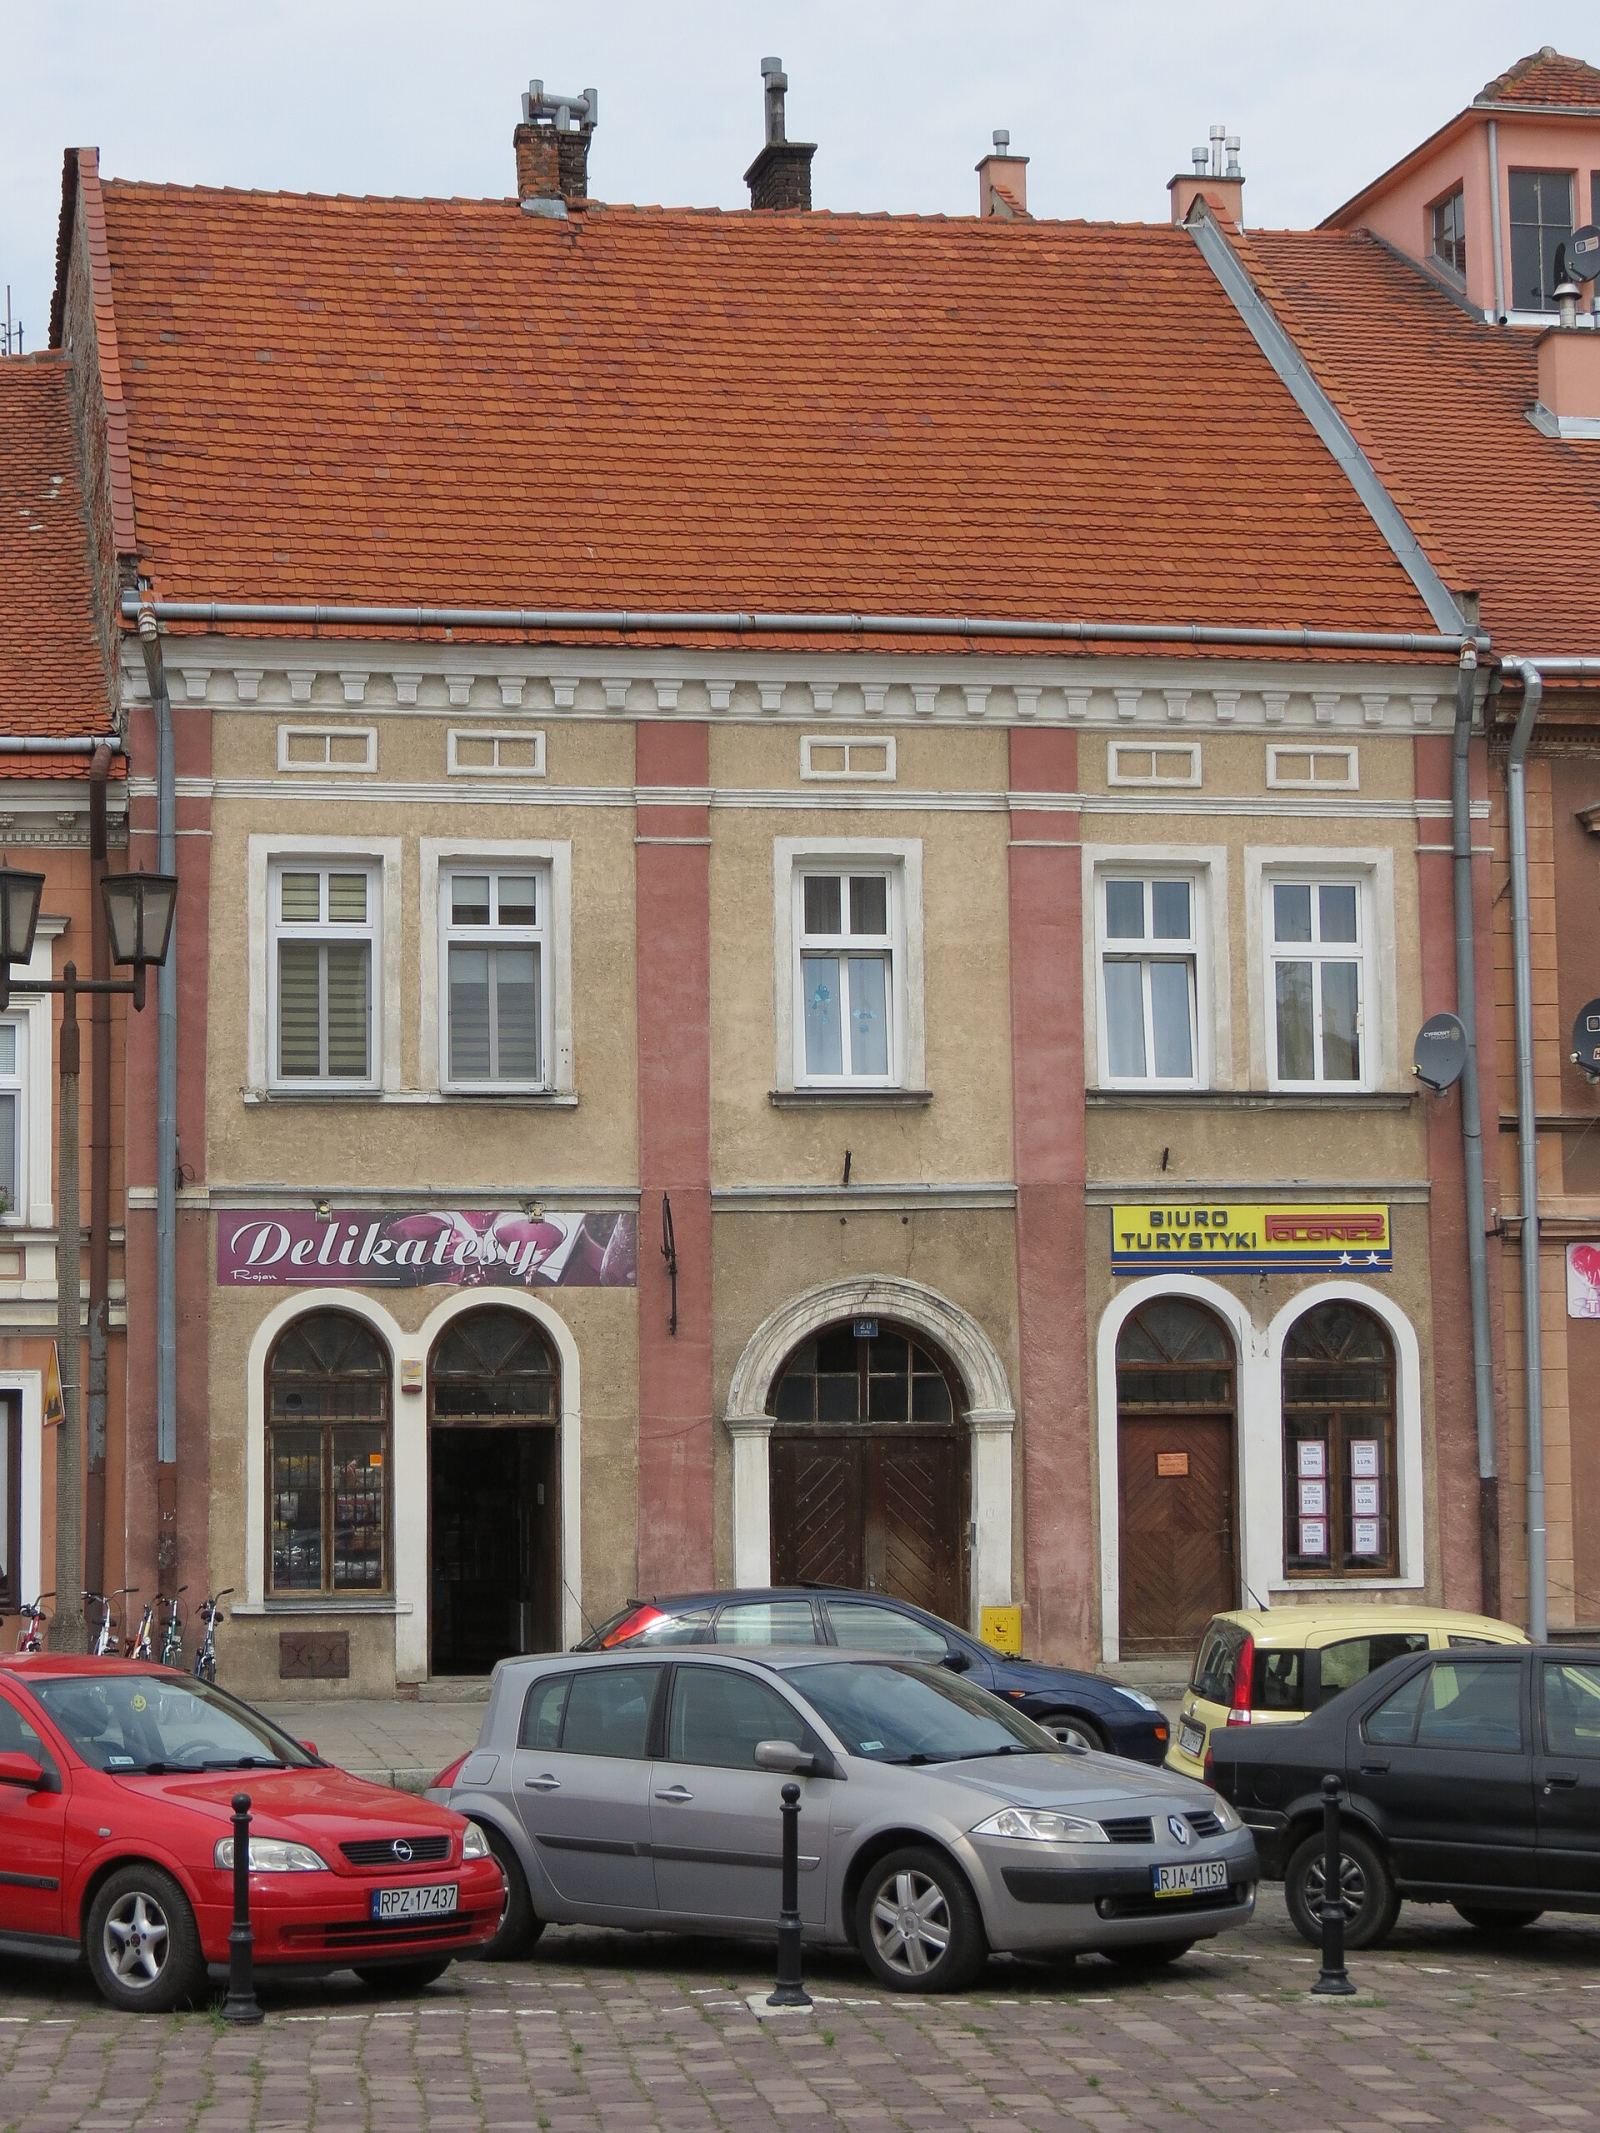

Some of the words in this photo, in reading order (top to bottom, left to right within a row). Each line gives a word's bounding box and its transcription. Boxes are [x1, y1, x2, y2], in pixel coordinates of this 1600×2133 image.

[1149, 1210, 1228, 1227] BIURO
[1264, 1213, 1385, 1242] POLONEZ
[230, 1221, 538, 1275] Delikatesy
[1121, 1232, 1257, 1249] TURYSTYKI
[230, 1269, 278, 1282] Rojan
[860, 1321, 872, 1330] 20
[1160, 1868, 1187, 1890] RJA
[1190, 1863, 1225, 1887] 41159
[381, 1890, 410, 1914] RPZ
[415, 1887, 456, 1911] 17437
